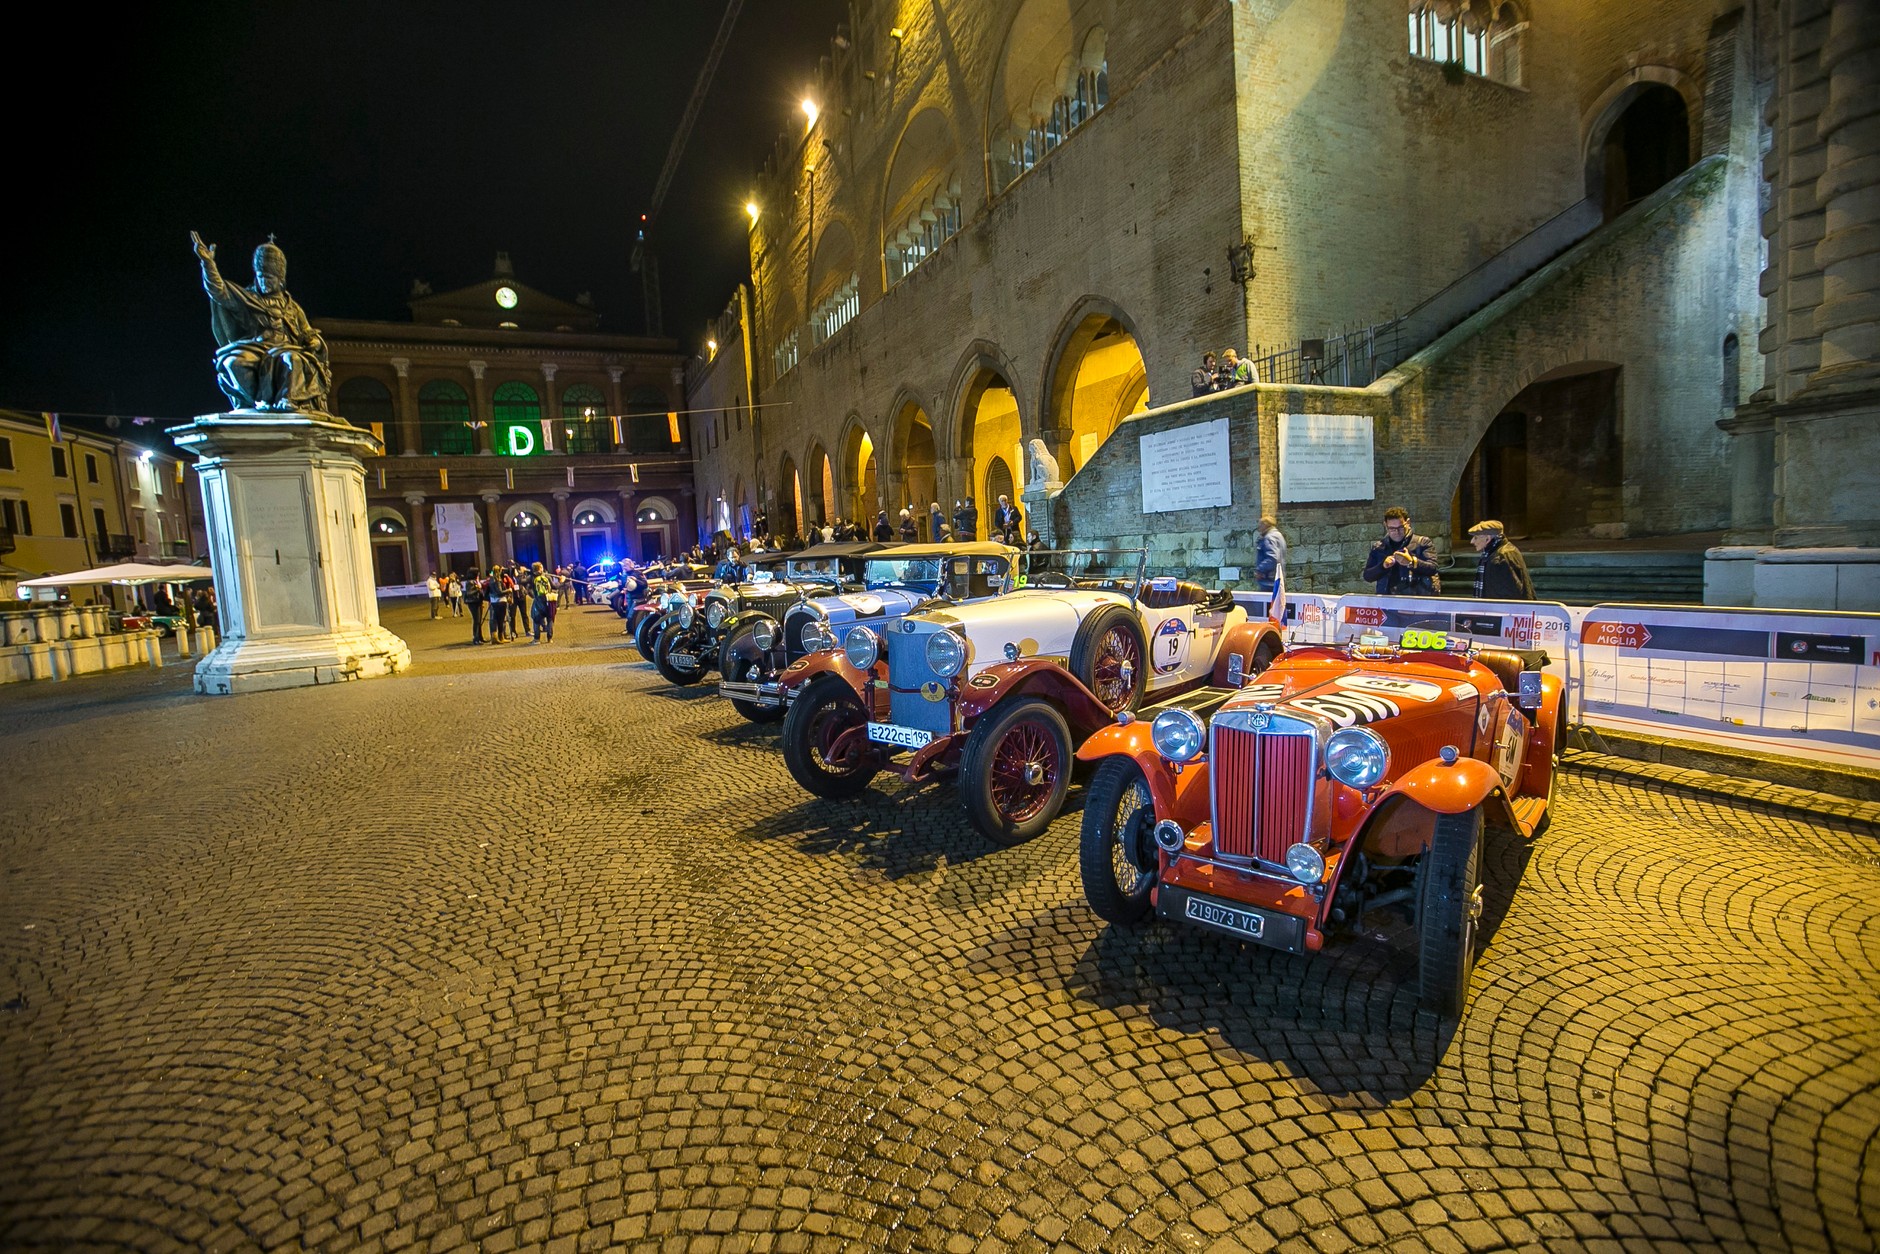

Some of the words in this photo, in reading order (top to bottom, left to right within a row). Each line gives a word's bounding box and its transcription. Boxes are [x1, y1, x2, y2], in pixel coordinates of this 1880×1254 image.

[508, 425, 534, 456] D
[1013, 574, 1028, 588] 19
[1303, 599, 1321, 614] Mille
[1322, 606, 1338, 615] 2016
[1356, 608, 1378, 616] 1000
[1298, 611, 1321, 627] Miglia
[1354, 616, 1379, 625] MIGLIA
[1513, 611, 1543, 629] Mille
[1545, 621, 1570, 631] 2016
[1504, 627, 1541, 648] Miglia
[1600, 625, 1636, 635] 1000
[1168, 637, 1179, 657] 19
[1401, 630, 1447, 650] 806
[1596, 635, 1637, 646] MIGLIA
[871, 726, 912, 744] E222CE
[912, 731, 930, 743] 199
[1190, 902, 1235, 926] 219073
[1241, 915, 1258, 932] VC
